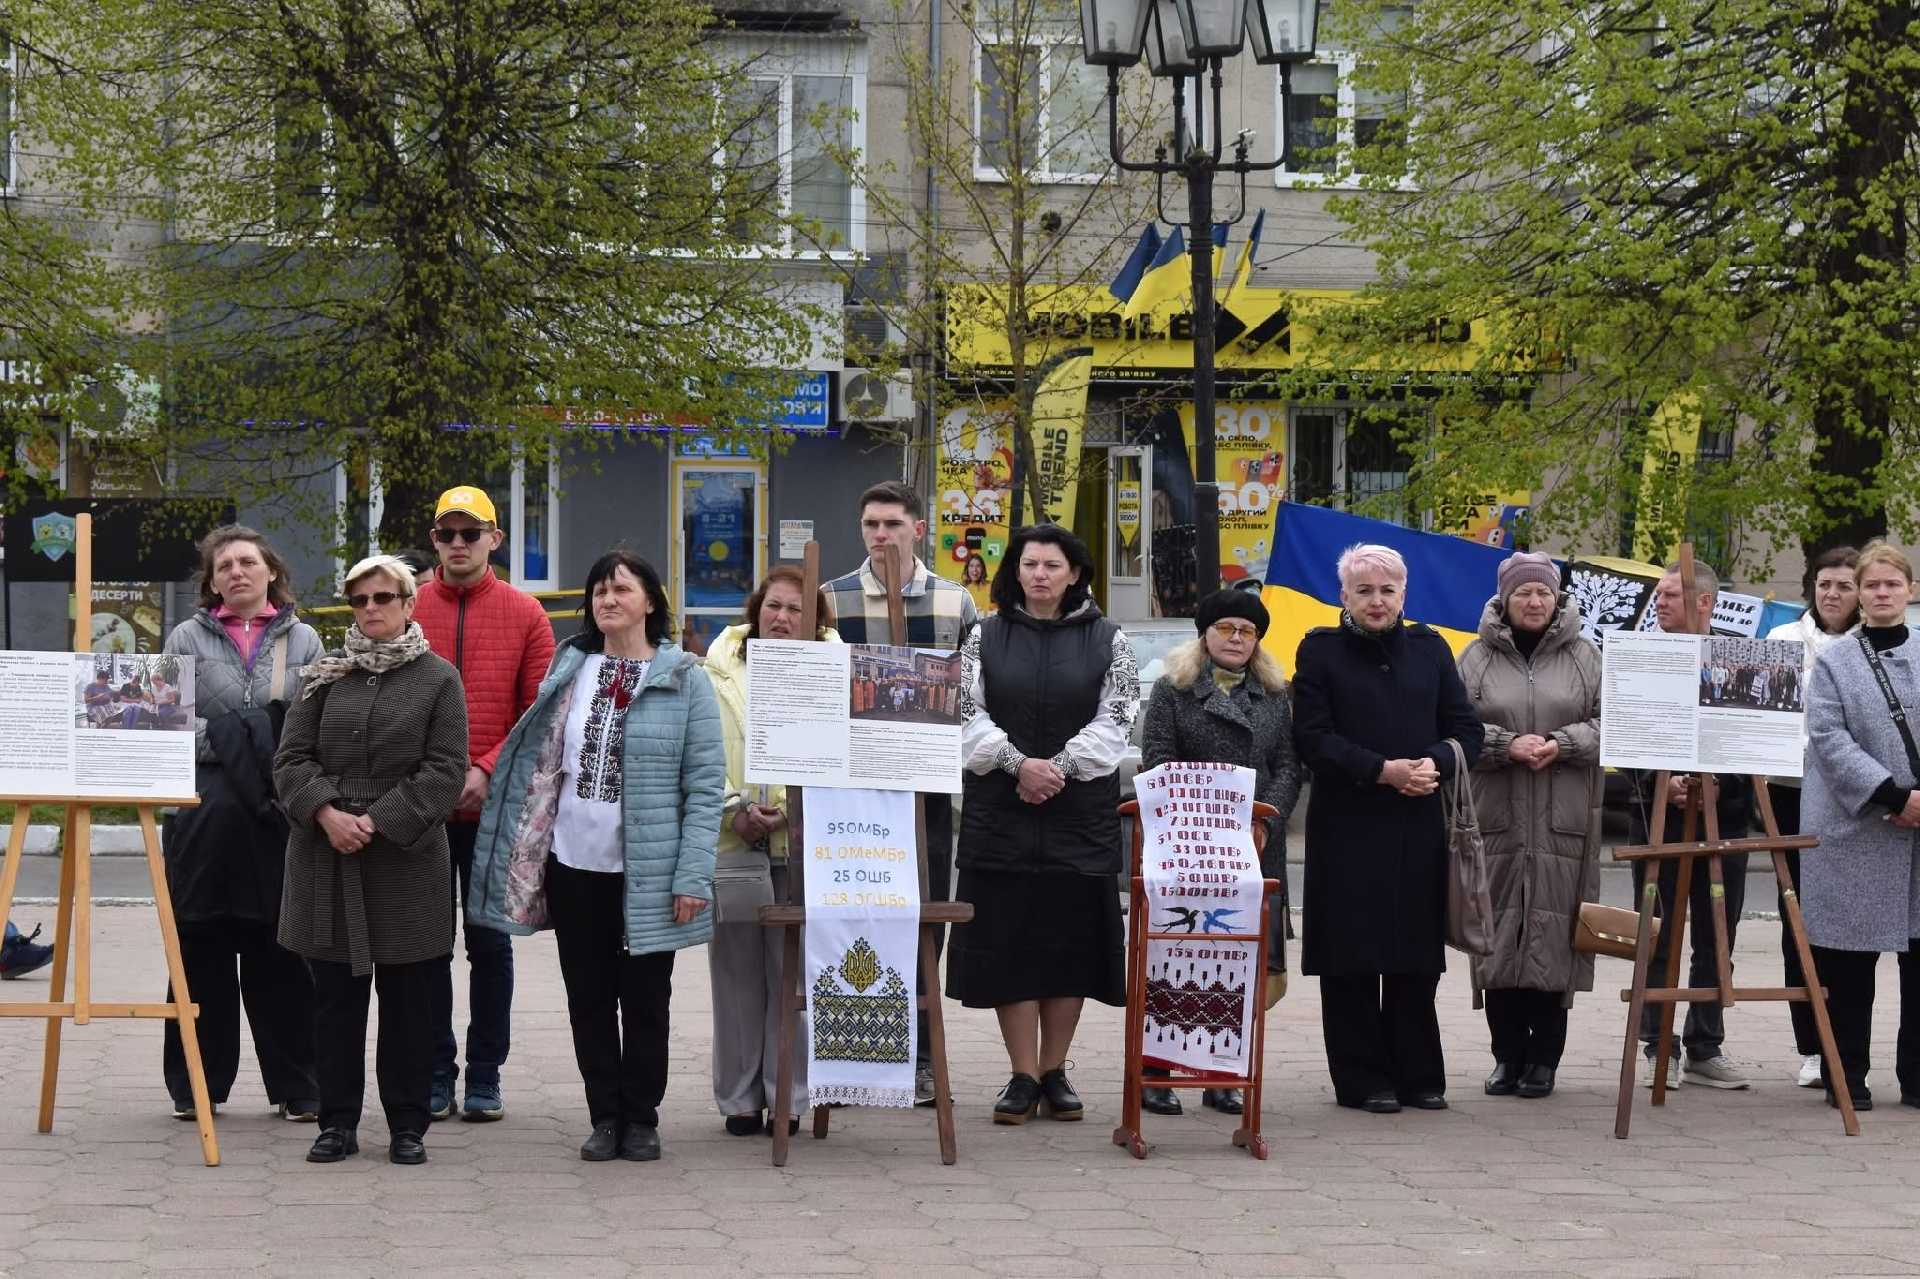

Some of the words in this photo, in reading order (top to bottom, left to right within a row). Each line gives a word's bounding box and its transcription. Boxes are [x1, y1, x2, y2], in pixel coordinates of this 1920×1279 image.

[1050, 428, 1069, 507] TREND
[942, 513, 1005, 524] КРЕДИТ
[91, 590, 144, 601] ДЕСЕРТИ
[833, 869, 850, 883] 25
[855, 869, 891, 884] ОШБ
